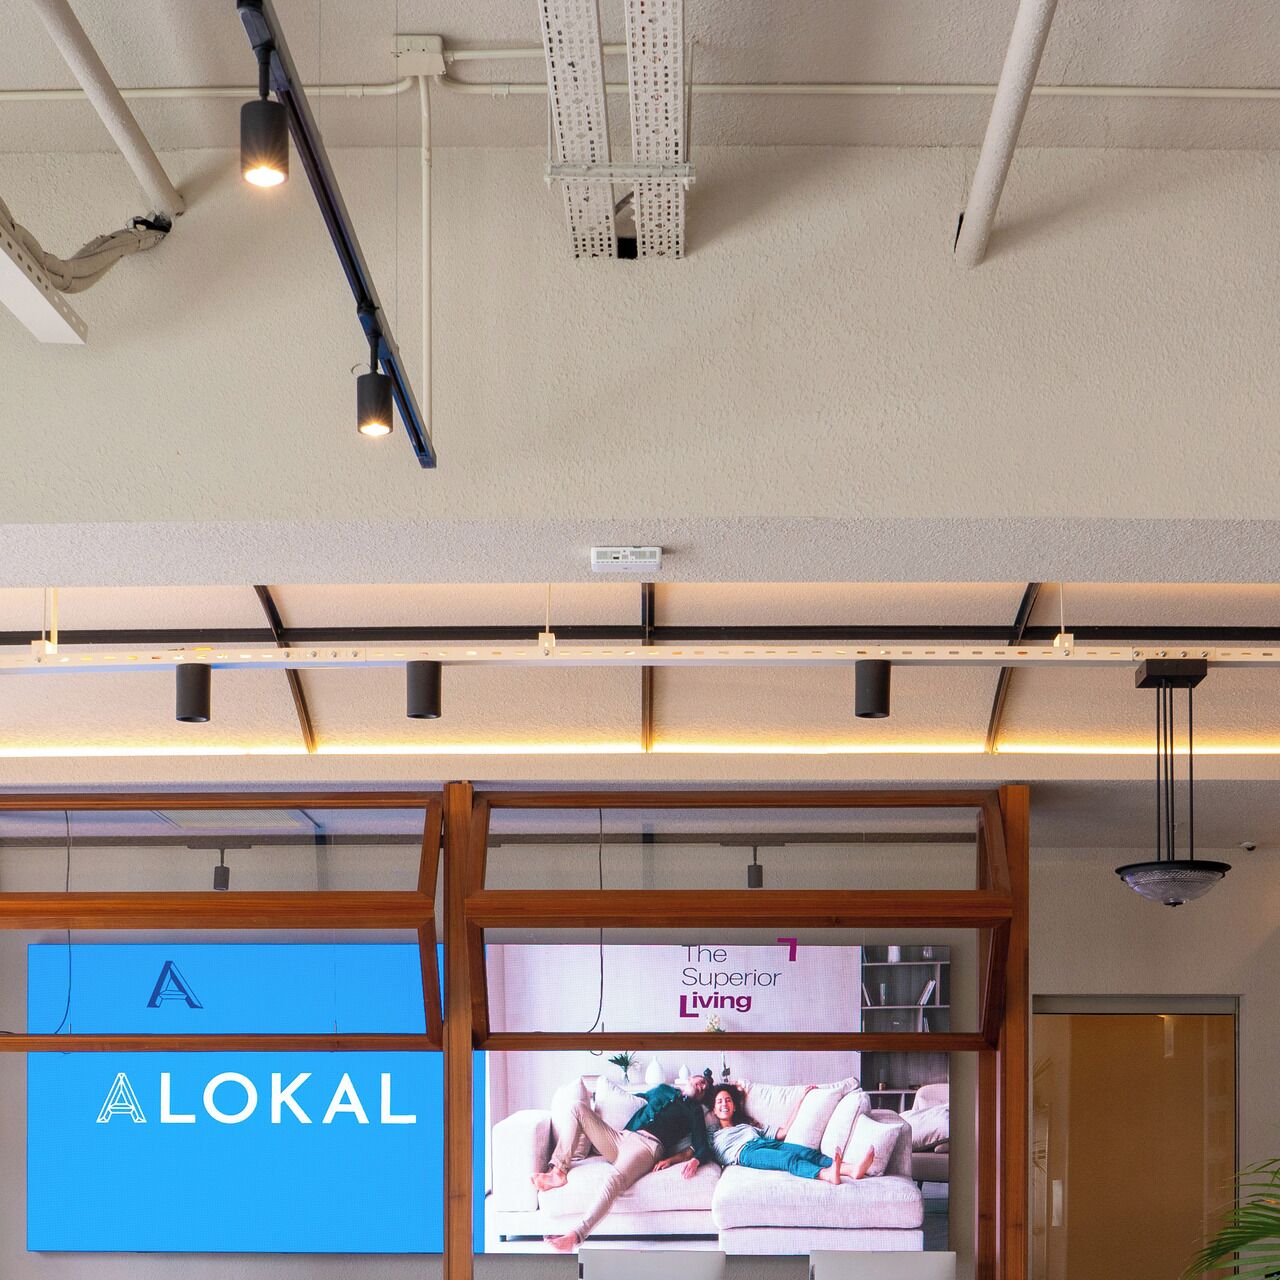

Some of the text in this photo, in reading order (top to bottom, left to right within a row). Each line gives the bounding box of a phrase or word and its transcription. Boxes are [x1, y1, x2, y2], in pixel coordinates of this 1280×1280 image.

[681, 944, 727, 963] The
[146, 960, 204, 1009] A
[681, 967, 782, 989] Superior
[679, 991, 752, 1018] Living
[96, 1072, 417, 1125] ALOKAL
